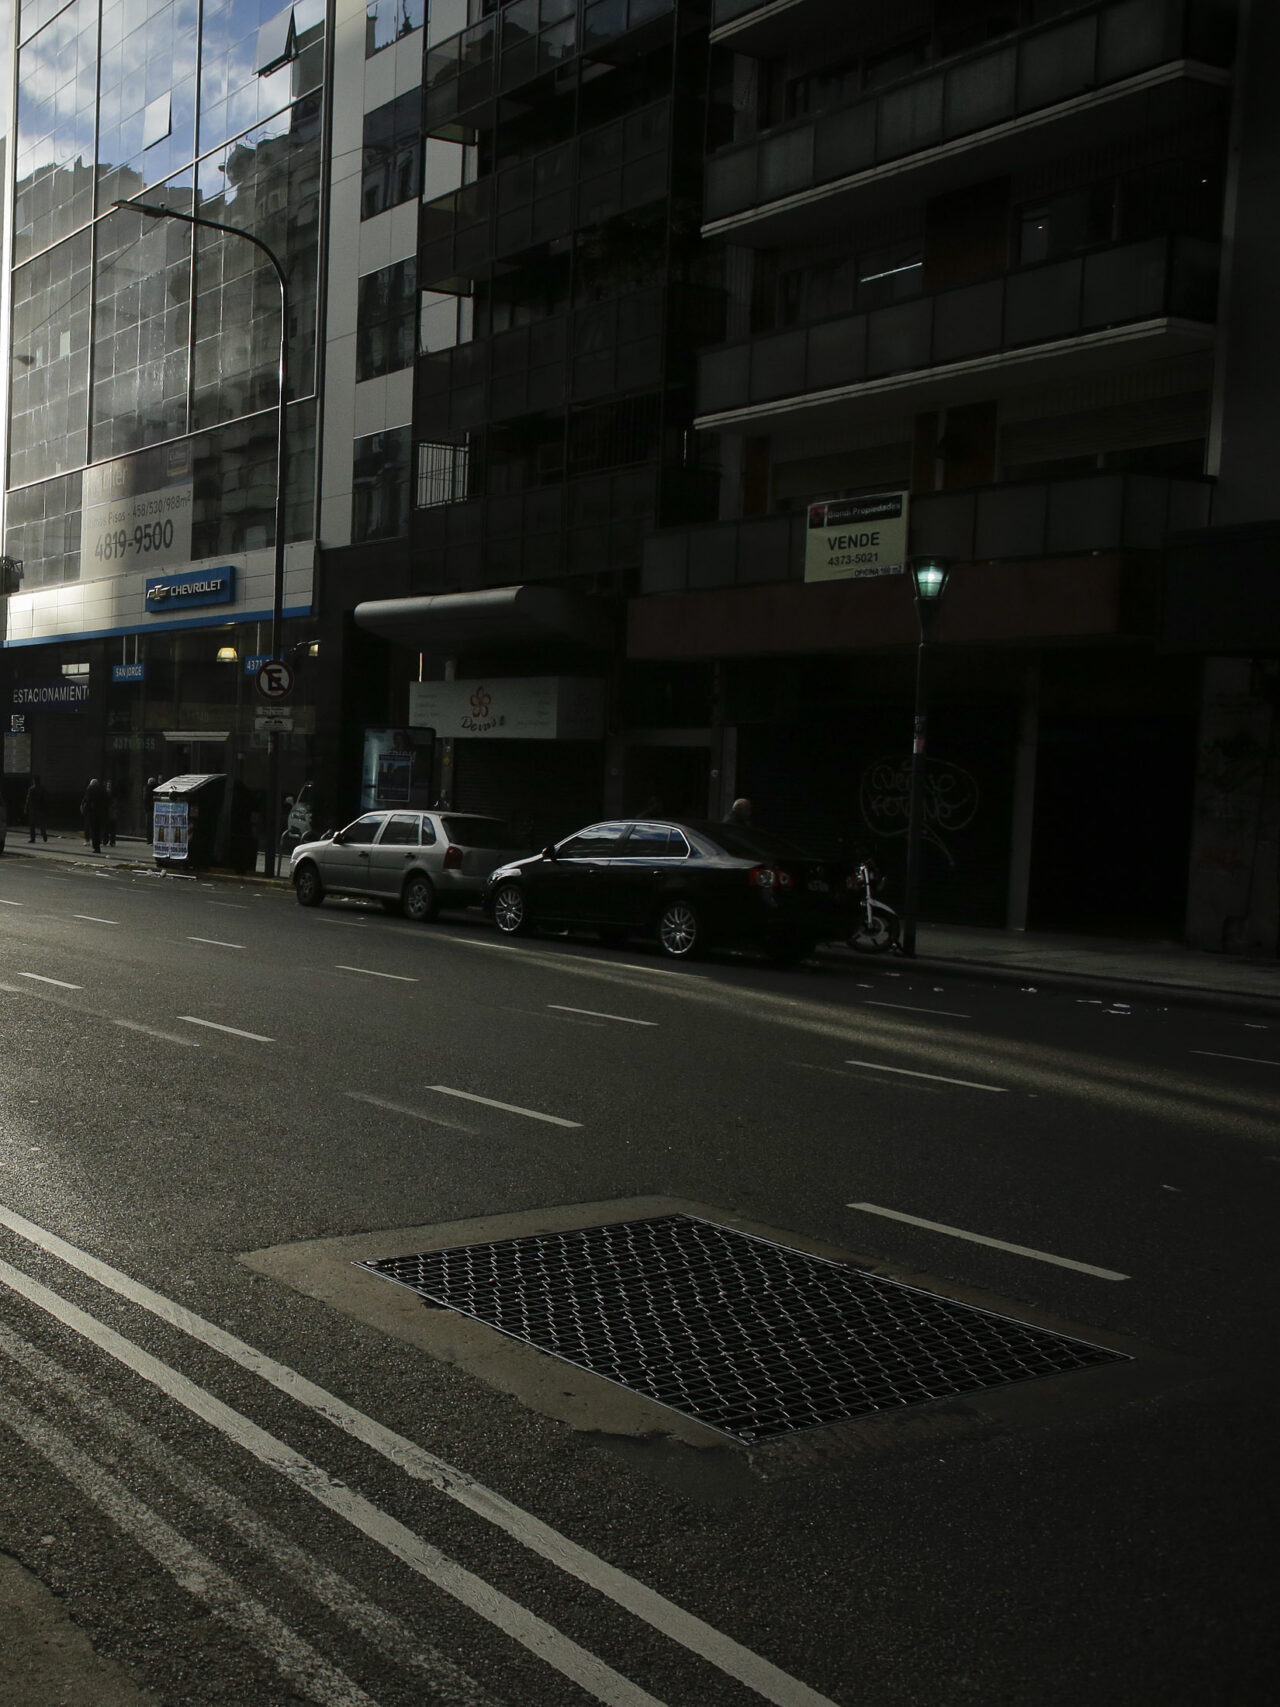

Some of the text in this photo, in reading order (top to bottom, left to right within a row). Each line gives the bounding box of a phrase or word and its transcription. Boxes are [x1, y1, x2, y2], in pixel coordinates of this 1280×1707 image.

[95, 519, 174, 561] 4819-9500
[827, 532, 880, 551] VENDE
[828, 552, 879, 567] 4373-5021
[170, 579, 222, 597] CHEVROLET
[115, 666, 142, 678] SAN JORGE
